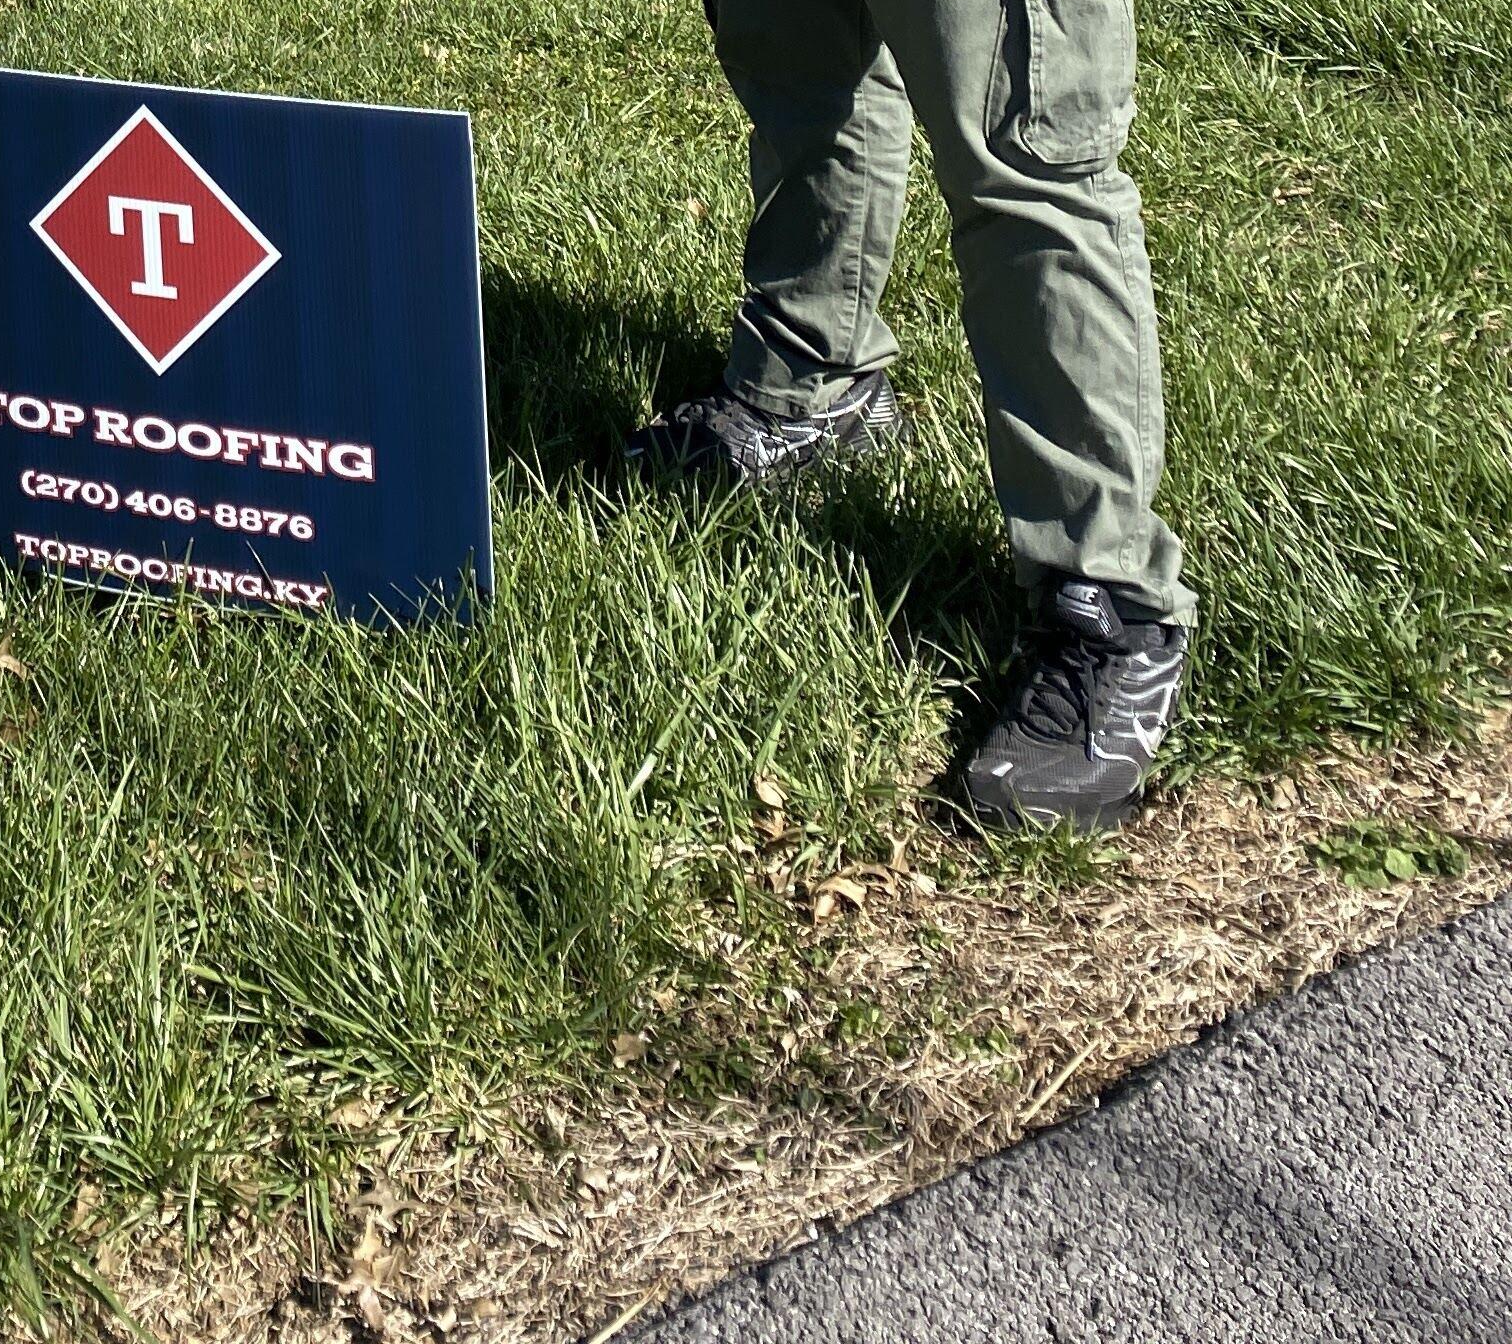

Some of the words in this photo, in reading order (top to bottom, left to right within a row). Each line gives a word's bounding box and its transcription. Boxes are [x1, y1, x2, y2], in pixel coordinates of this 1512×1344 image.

[107, 194, 195, 300] T
[92, 407, 375, 480] ROOFING
[20, 469, 120, 510] (270)
[124, 489, 315, 541] 406-8876
[14, 533, 328, 608] TOPROOFING.KY
